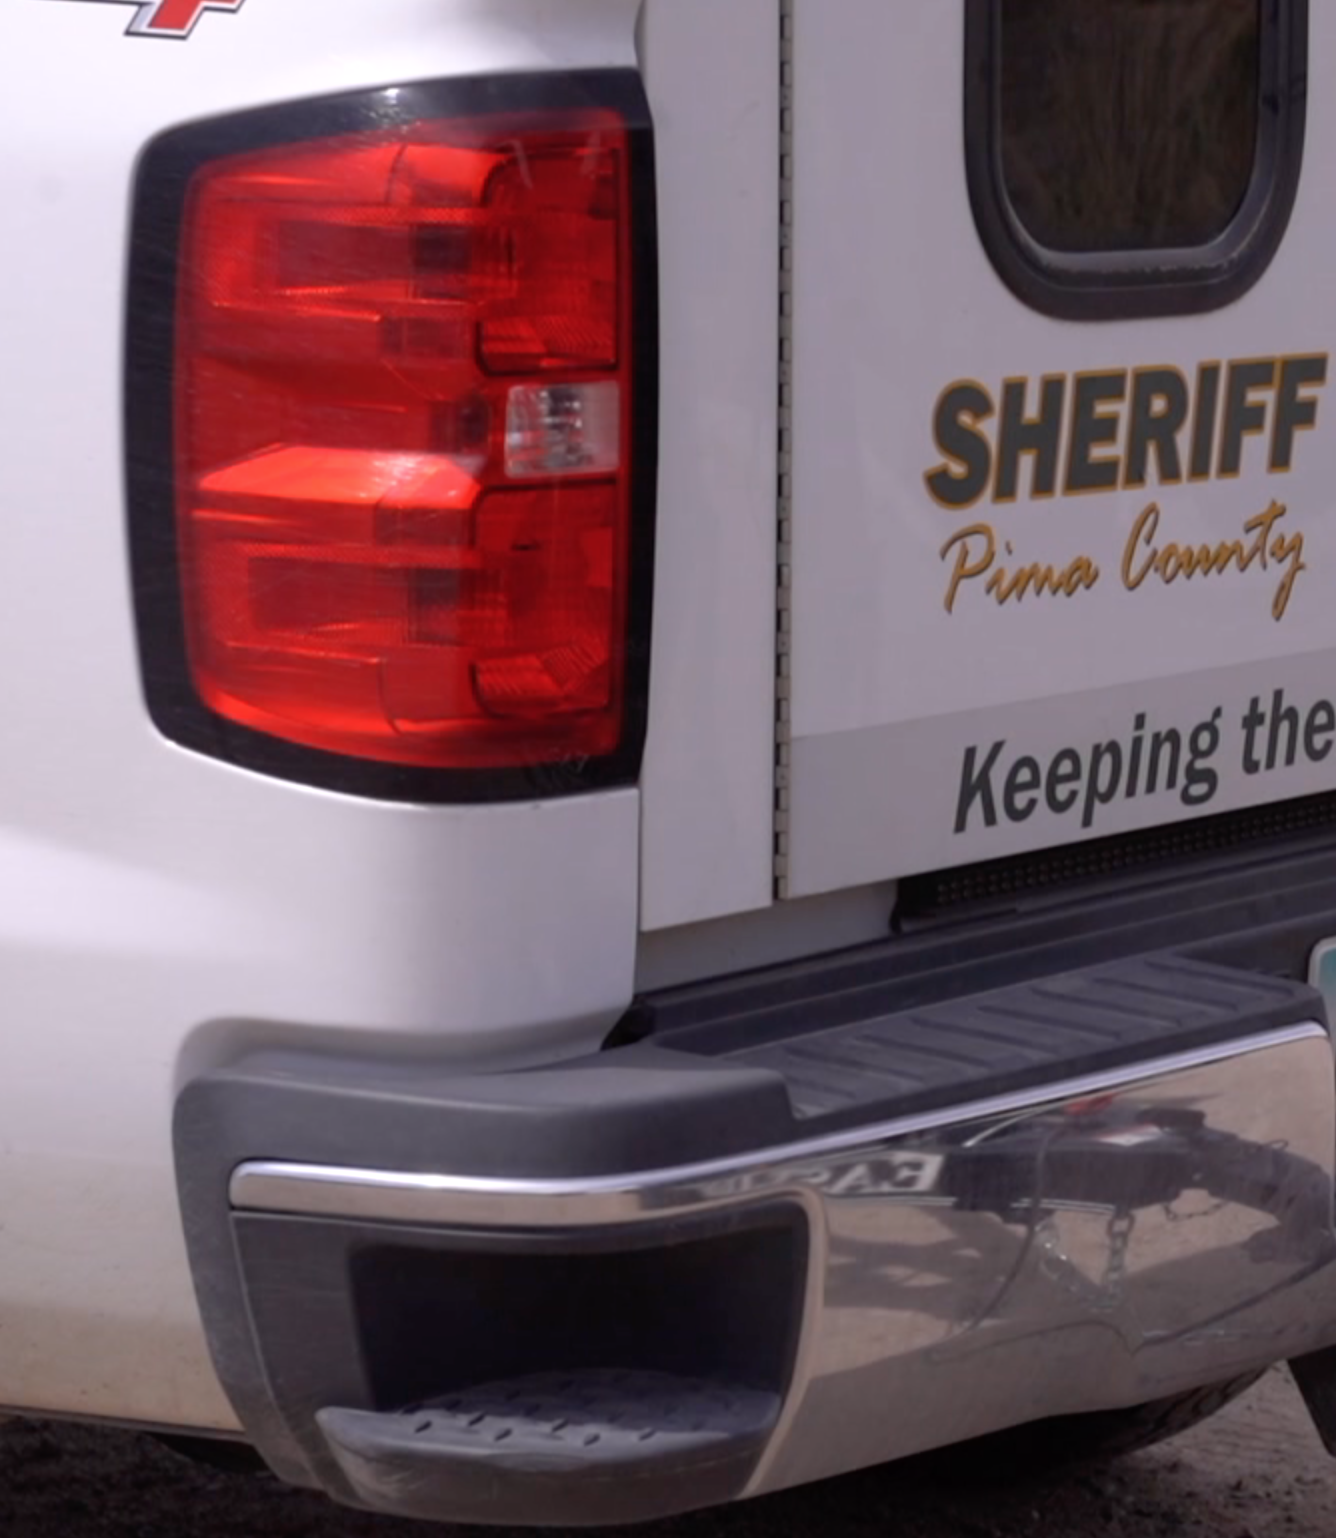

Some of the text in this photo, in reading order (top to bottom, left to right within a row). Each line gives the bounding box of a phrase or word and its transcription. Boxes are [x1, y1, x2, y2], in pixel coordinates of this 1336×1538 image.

[922, 351, 1328, 511] SHERIFF
[939, 499, 1307, 622] Pima County
[953, 705, 1223, 835] Keeping
[1241, 688, 1336, 776] the
